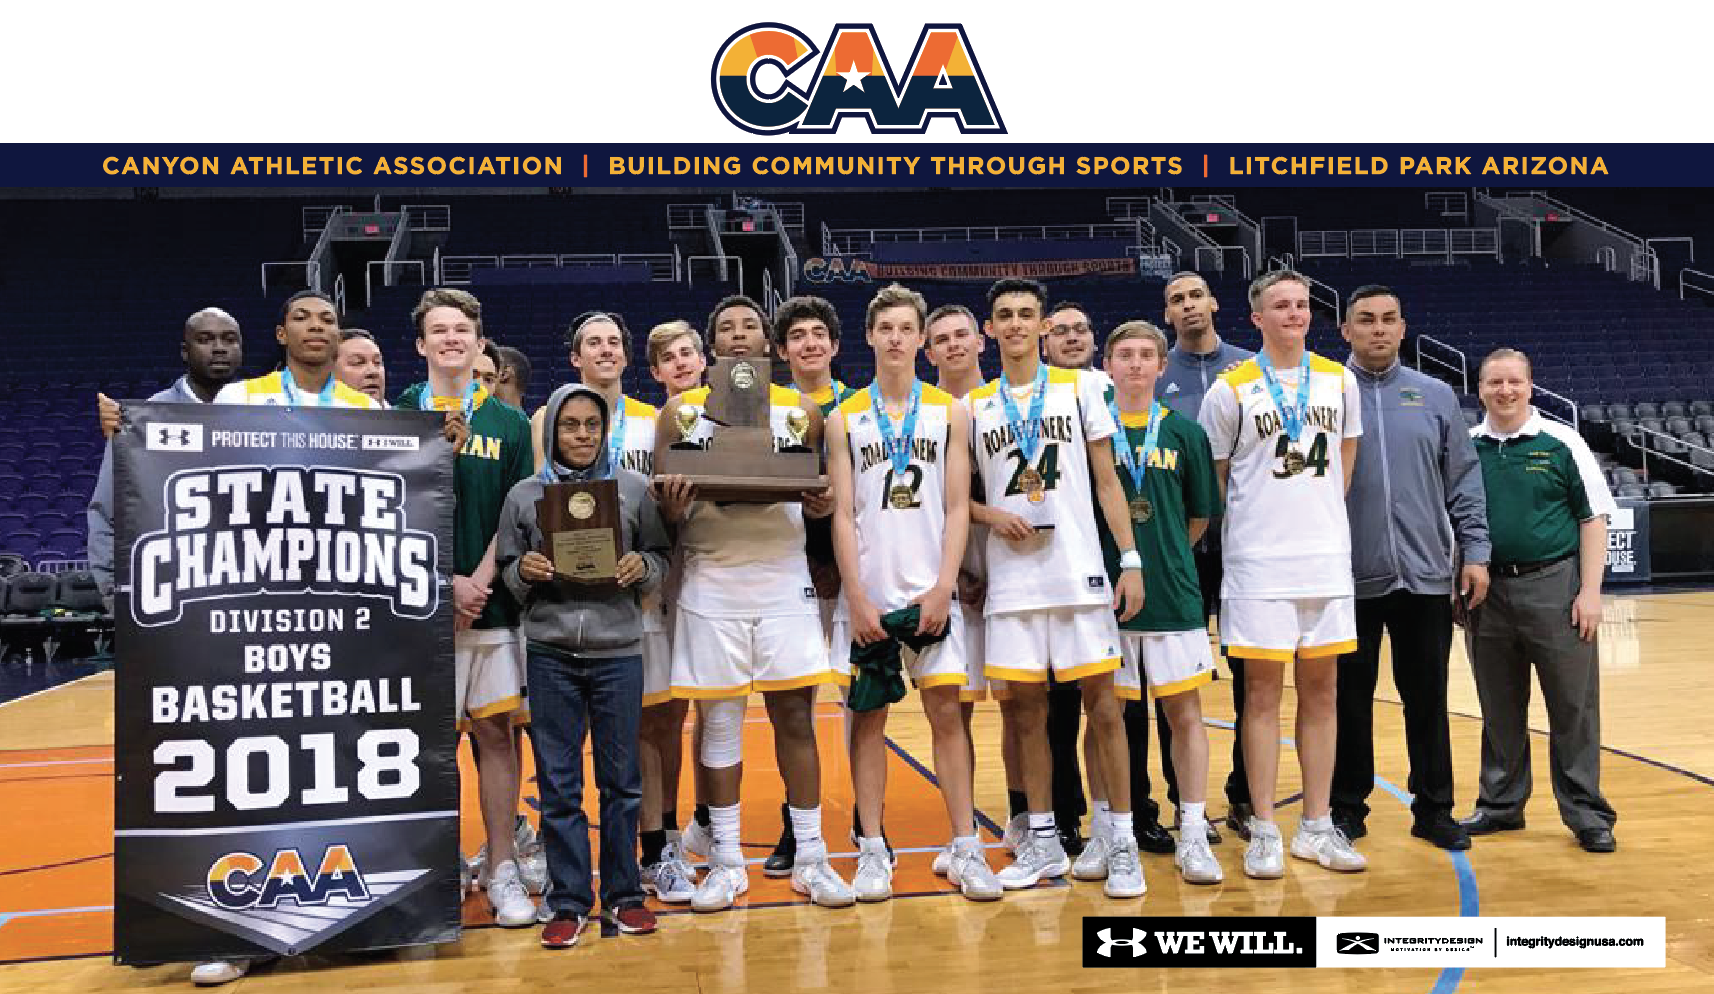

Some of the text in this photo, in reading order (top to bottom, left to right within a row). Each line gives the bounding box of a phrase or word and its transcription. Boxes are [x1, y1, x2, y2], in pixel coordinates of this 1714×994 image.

[804, 258, 872, 282] CAA
[212, 431, 278, 448] PROTECT
[281, 432, 307, 448] THIS
[882, 464, 923, 510] 12
[1005, 442, 1061, 497] 24
[175, 471, 397, 531] STATE
[141, 528, 429, 614] CHAMPIONS
[210, 606, 371, 633] DIVISION 2
[244, 642, 331, 674] BOYS
[152, 676, 422, 723] BASKETBALL
[153, 728, 420, 812] 2018
[207, 844, 373, 911] CAA
